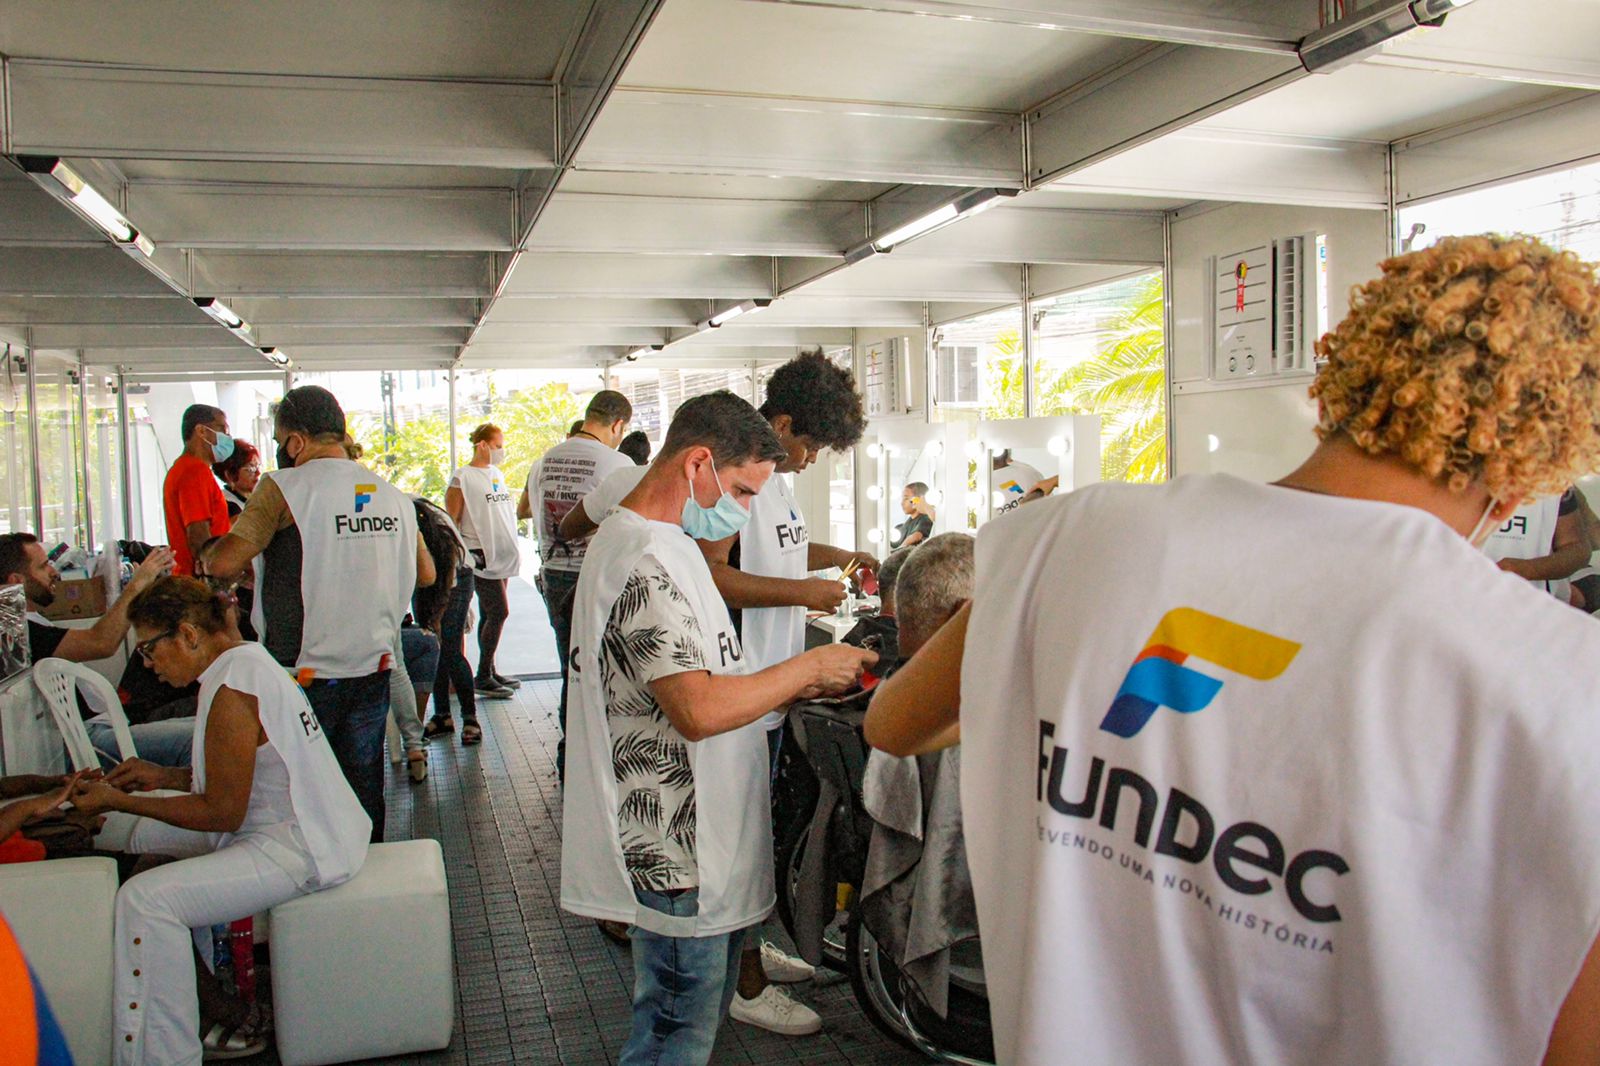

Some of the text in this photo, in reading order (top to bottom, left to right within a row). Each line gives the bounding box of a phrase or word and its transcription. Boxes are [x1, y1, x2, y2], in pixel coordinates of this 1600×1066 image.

[1037, 820, 1335, 954] EVENDO UMA NOVA HISTÓRIA
